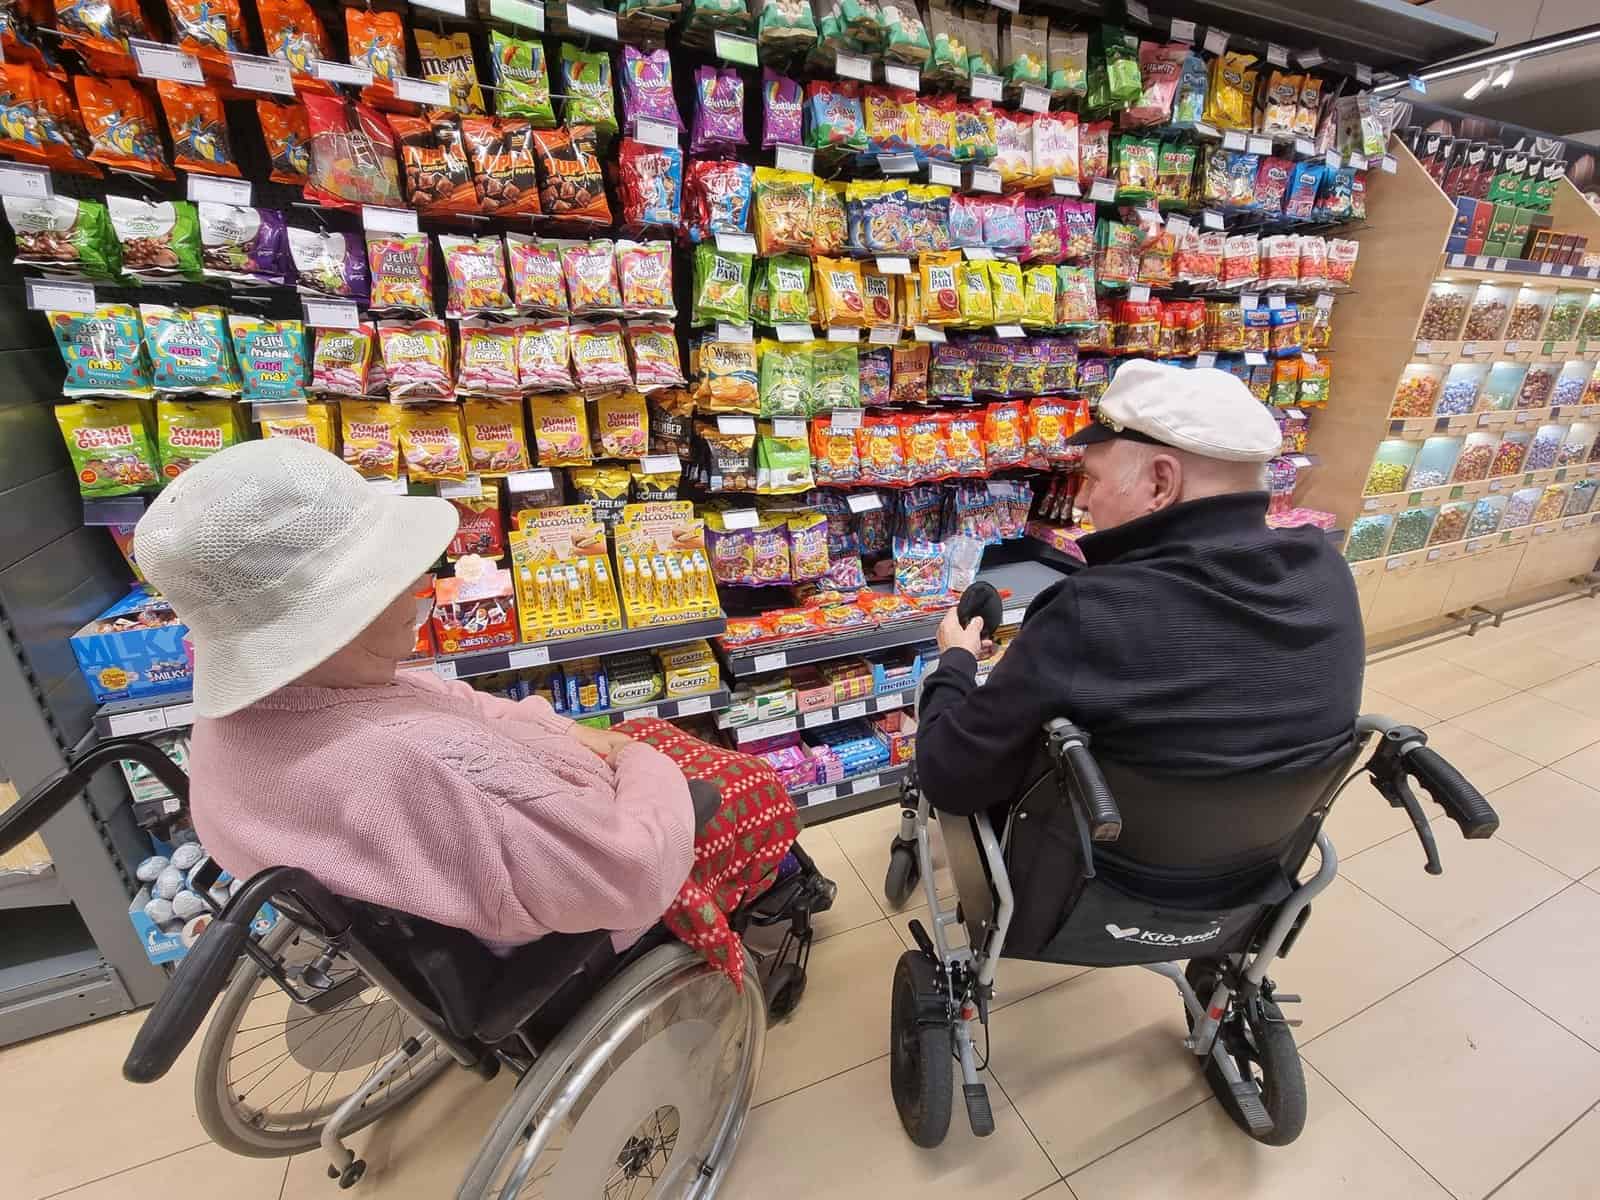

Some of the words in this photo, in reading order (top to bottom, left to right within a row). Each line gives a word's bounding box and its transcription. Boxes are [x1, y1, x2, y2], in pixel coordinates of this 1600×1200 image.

[717, 261, 742, 272] BON
[716, 270, 741, 281] PARI
[931, 268, 951, 278] BON
[931, 278, 952, 289] PARI
[254, 336, 284, 348] Jelly
[88, 359, 122, 371] max
[254, 360, 282, 371] mini
[260, 371, 288, 382] max
[650, 613, 700, 625] Lacasitos
[546, 622, 601, 639] Lacasitos
[154, 670, 186, 681] MILKY
[670, 676, 707, 690] LOCKETS
[880, 678, 915, 692] mentos
[613, 686, 651, 700] LOCKETS
